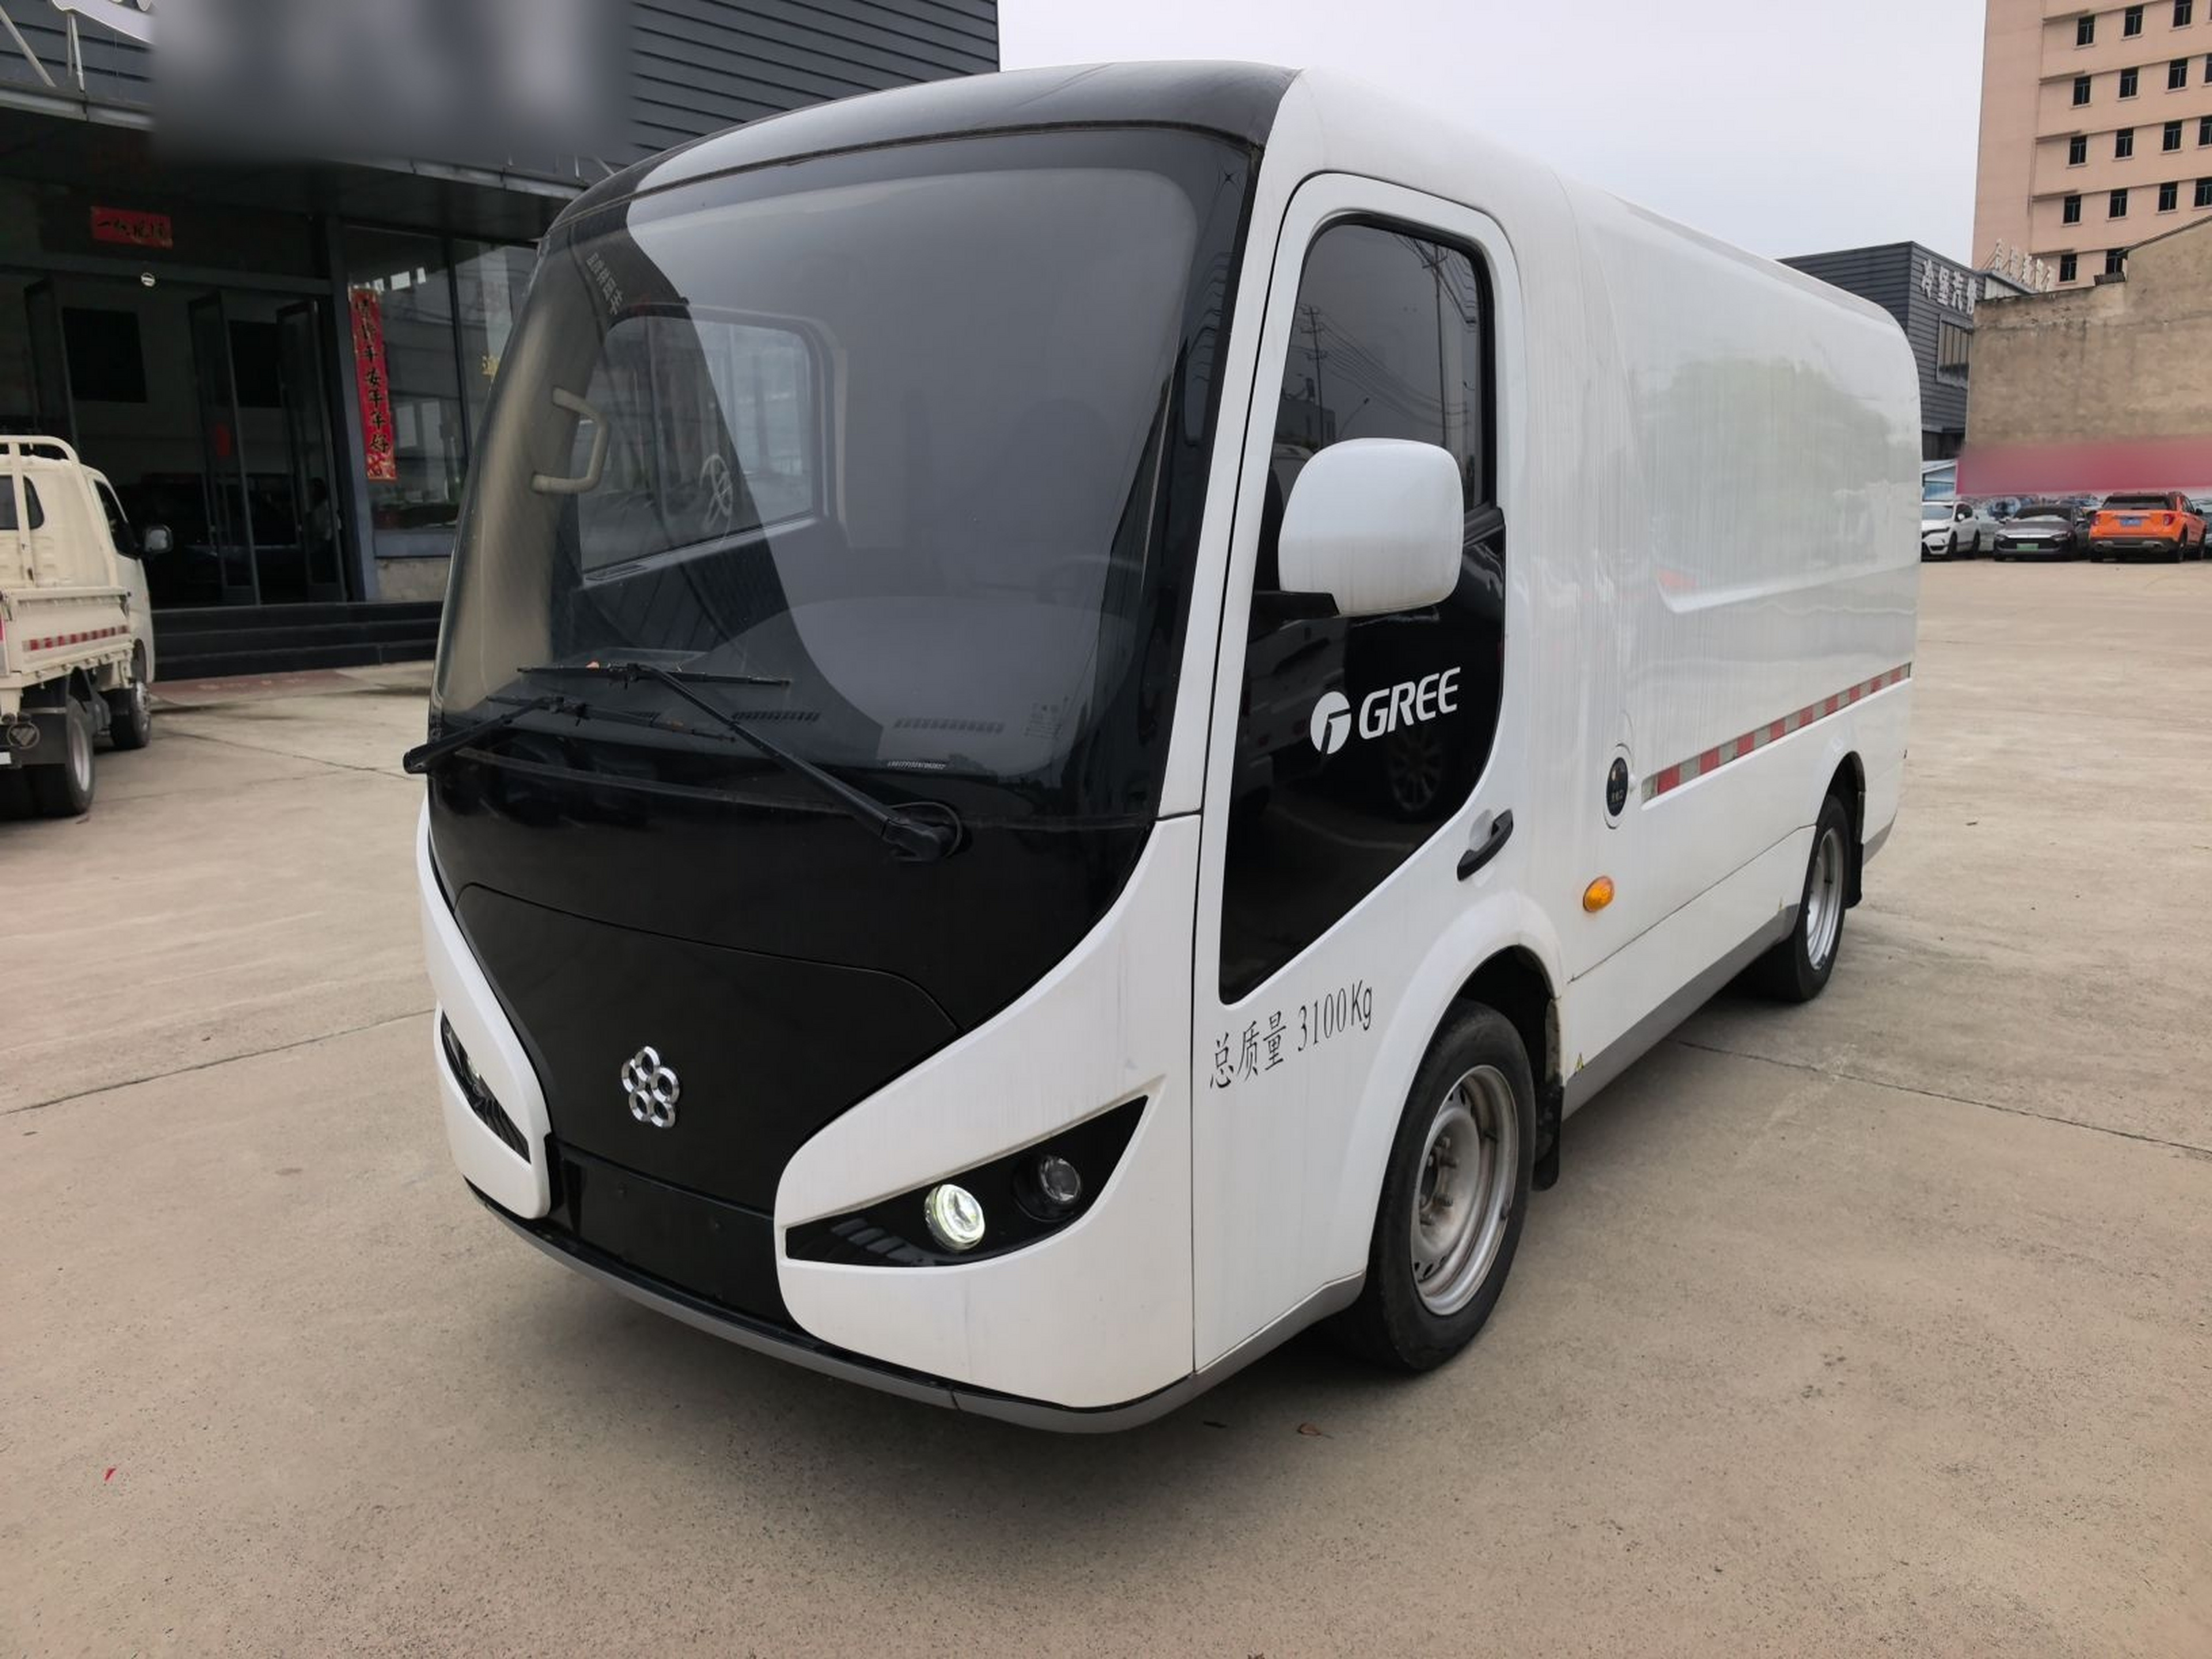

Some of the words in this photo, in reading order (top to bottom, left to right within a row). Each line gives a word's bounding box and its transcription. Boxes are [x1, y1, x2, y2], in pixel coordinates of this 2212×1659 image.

[1359, 666, 1461, 740] GREE
[1210, 1010, 1286, 1089] 总质量
[1298, 979, 1372, 1052] 3100Kg
